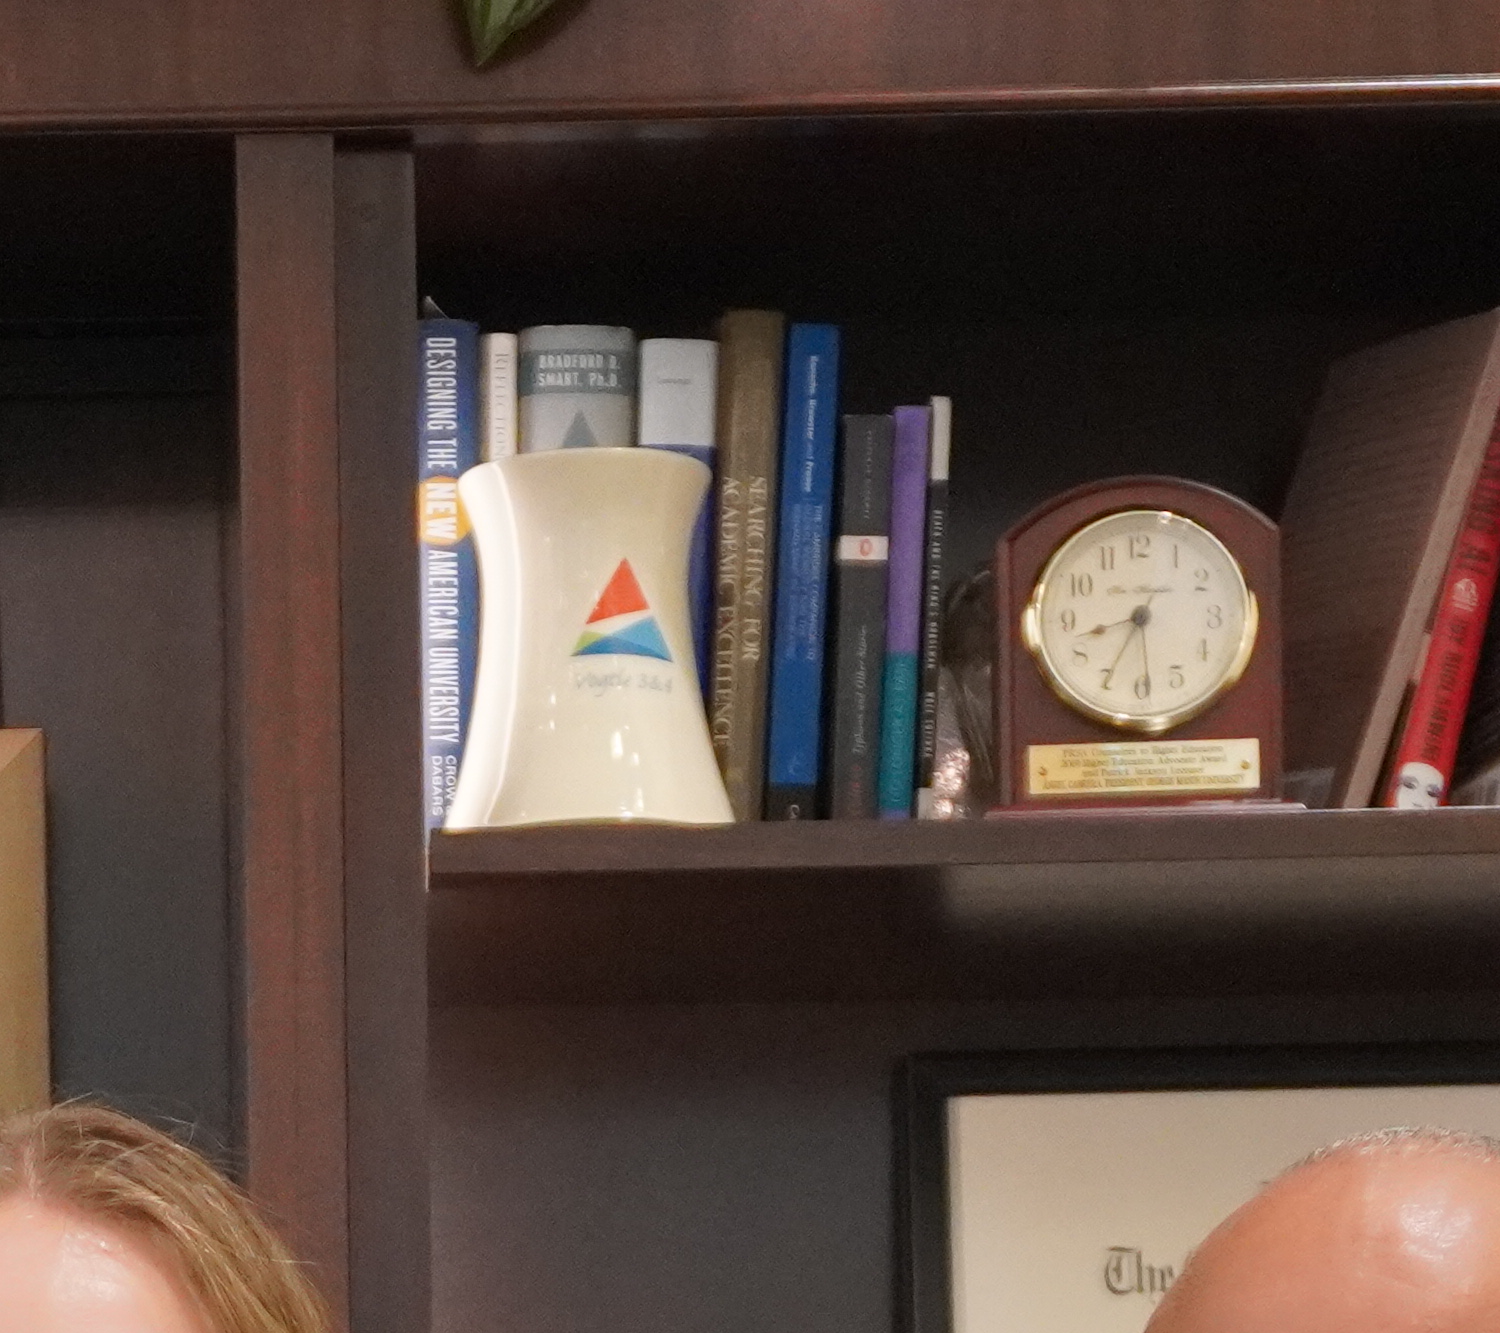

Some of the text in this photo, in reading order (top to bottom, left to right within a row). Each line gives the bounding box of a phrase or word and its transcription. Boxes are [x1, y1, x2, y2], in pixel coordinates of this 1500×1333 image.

[538, 353, 606, 370] BRADFORD
[426, 336, 460, 744] DESIGNING THE NEW AMERICAN UNIVERSITY
[1128, 535, 1152, 559] 12
[1100, 545, 1116, 570] 11
[1171, 543, 1180, 568] 1
[1456, 548, 1491, 577] AI
[740, 476, 767, 662] SEARCHING FOR
[1194, 566, 1210, 592] 2
[1069, 572, 1094, 597] 10
[711, 476, 743, 747] ACADEMIC EXCELLENCE
[1060, 609, 1076, 632] 9
[1206, 603, 1224, 630] 3
[1072, 645, 1089, 666] 8
[1196, 637, 1211, 662] 4
[1099, 667, 1115, 691] 7
[1134, 673, 1152, 700] 6
[1168, 663, 1186, 689] 5
[431, 755, 444, 816] DABARS
[445, 755, 459, 803] CROW
[1103, 1246, 1178, 1298] The
